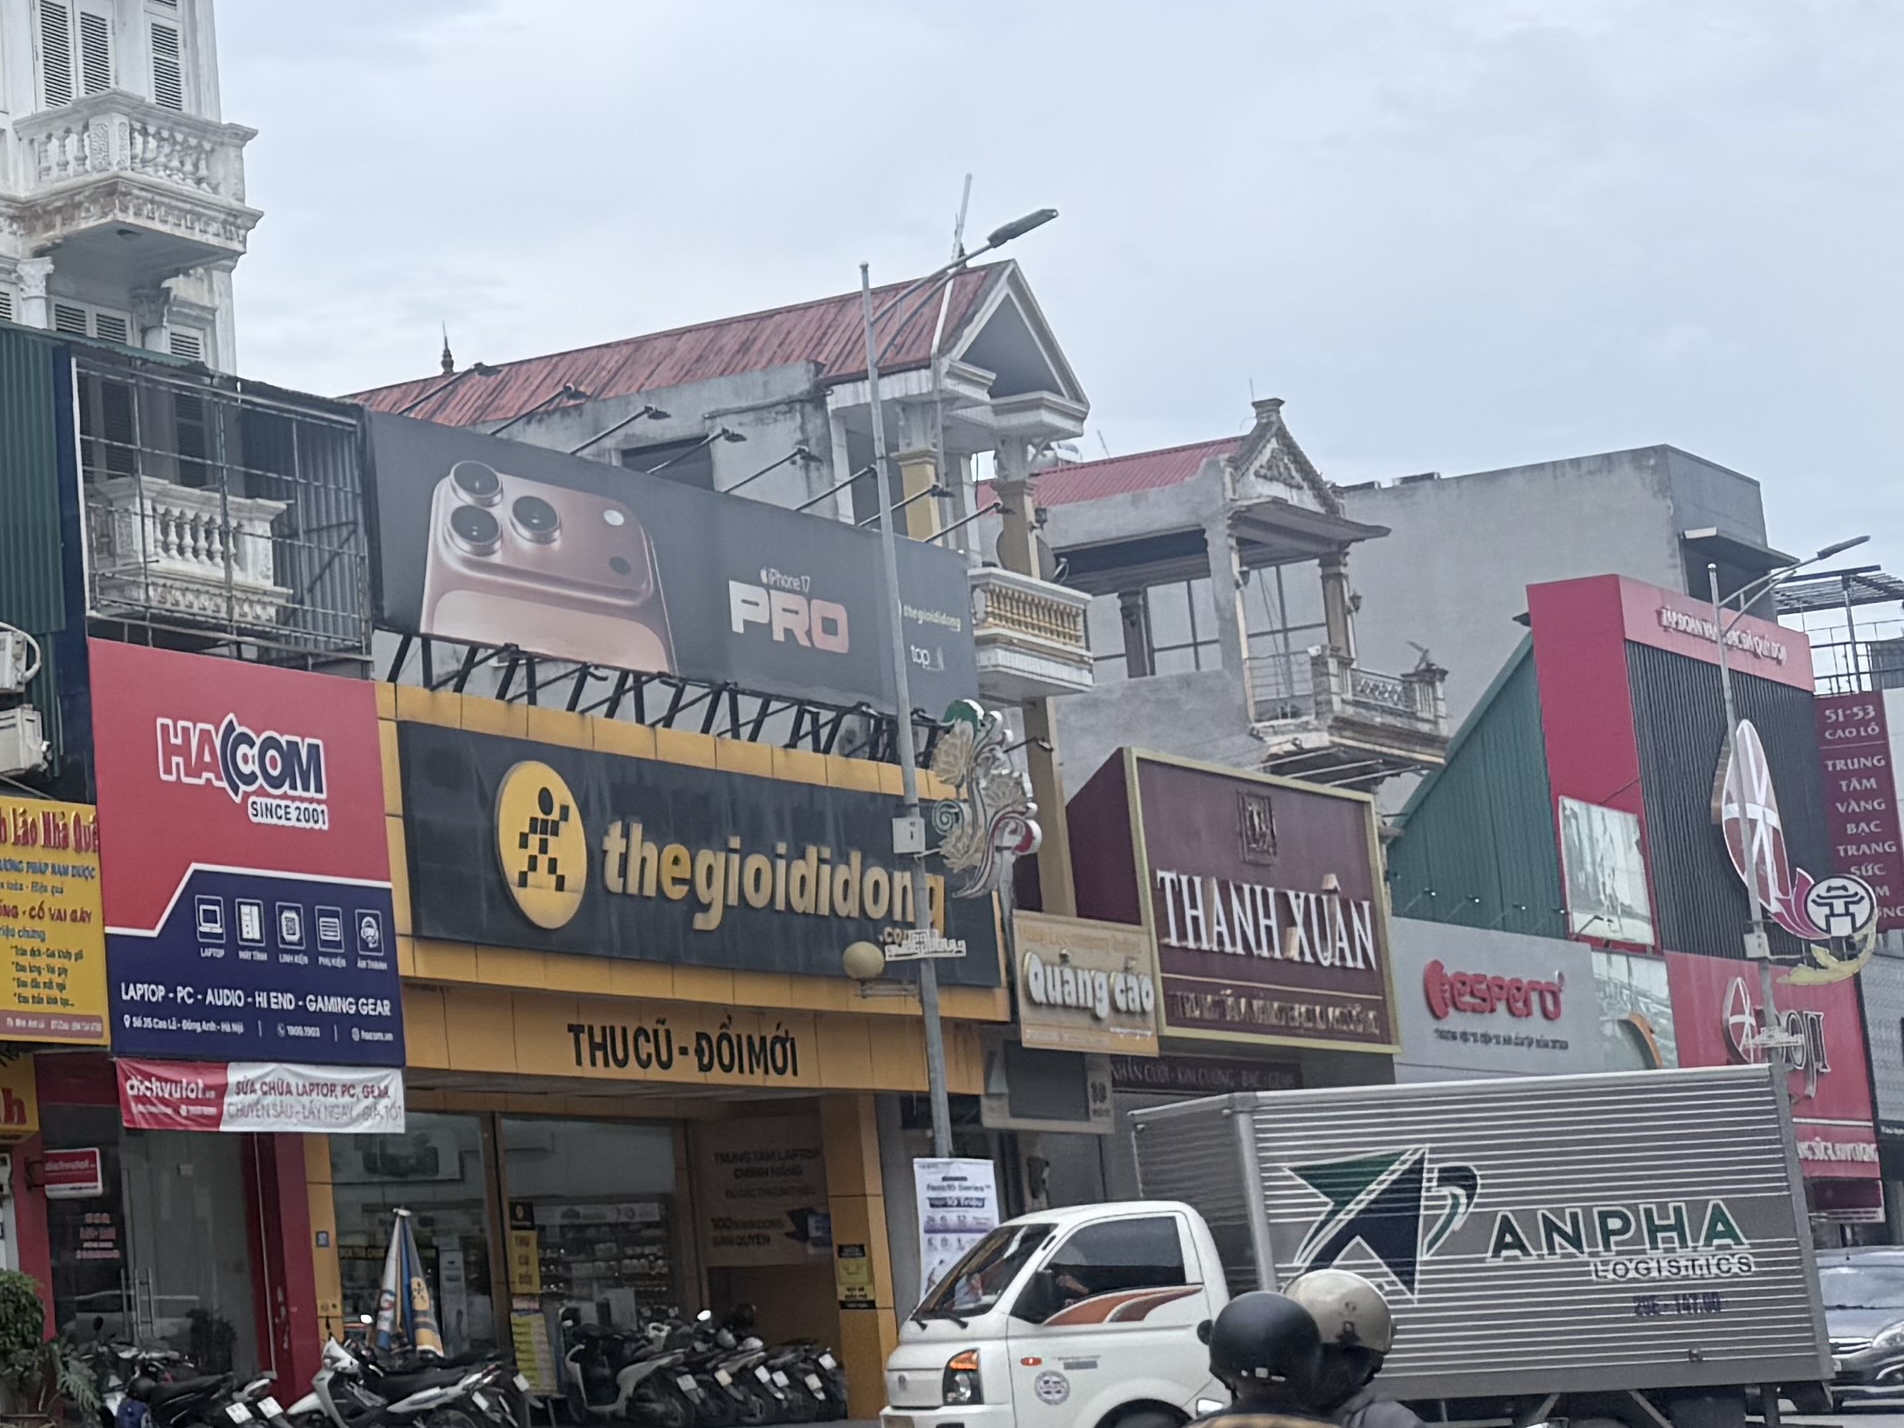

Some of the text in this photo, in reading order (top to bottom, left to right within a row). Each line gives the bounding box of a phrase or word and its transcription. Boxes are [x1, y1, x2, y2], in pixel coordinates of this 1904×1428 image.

[727, 579, 850, 654] PRO
[1825, 705, 1875, 722] 51-53
[1825, 727, 1856, 740] CAO
[156, 713, 327, 804] HACOM
[1826, 755, 1886, 771] TRUNG
[250, 800, 327, 826] SINCE 2001
[1835, 797, 1886, 813] VÀNG
[1846, 820, 1882, 836] BẠC
[1836, 840, 1897, 857] TRANG
[1156, 869, 1377, 971] THANH XUÂN
[121, 982, 391, 1016] LAPTOP PC AUDIO HI END GAMING GEAR
[567, 1022, 629, 1068] THU
[632, 1017, 675, 1070] CŨ
[742, 1021, 799, 1078] MỚI
[1485, 1200, 1751, 1262] ANPHA
[1592, 1254, 1755, 1281] LOGISTICS
